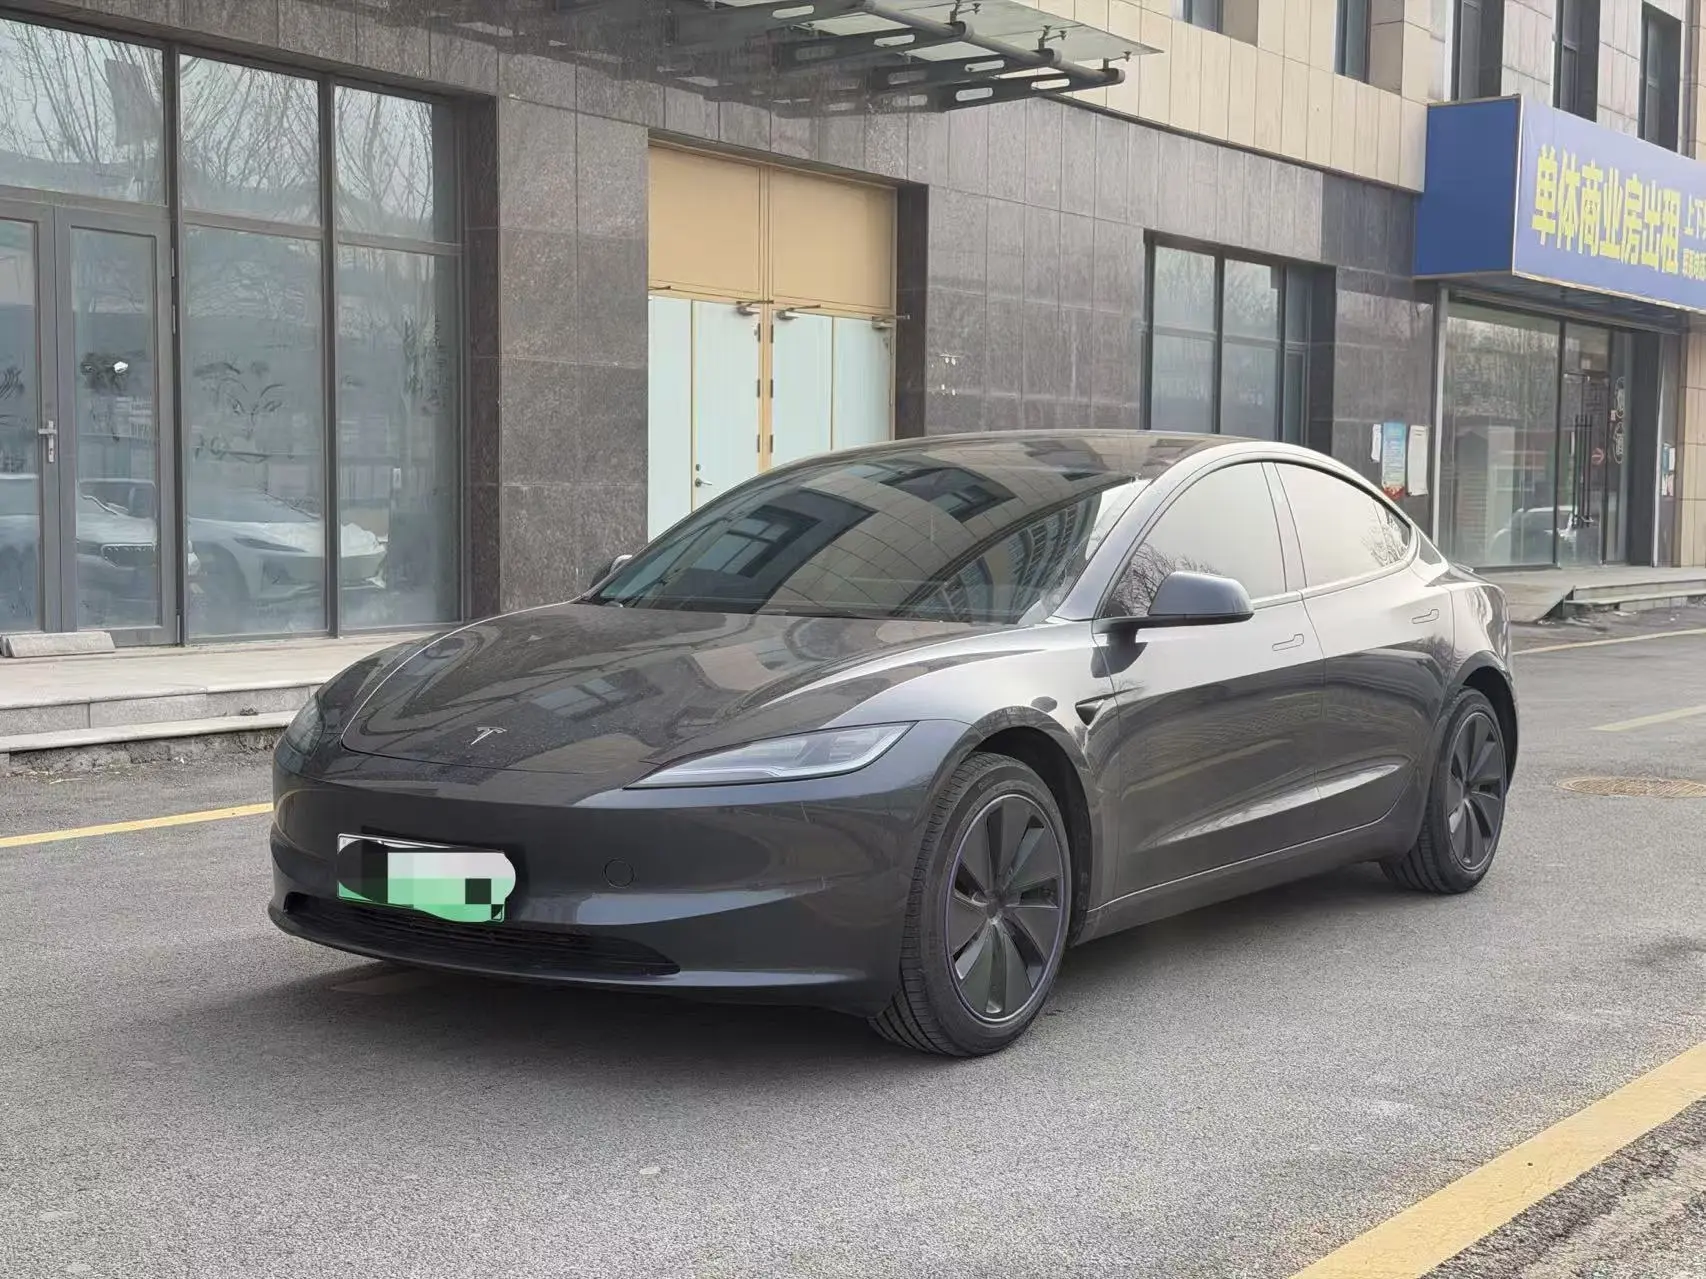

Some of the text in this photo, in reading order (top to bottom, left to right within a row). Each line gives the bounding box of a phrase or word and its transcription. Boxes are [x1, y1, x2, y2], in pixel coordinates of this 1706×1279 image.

[1532, 143, 1681, 274] 单体商业房出租
